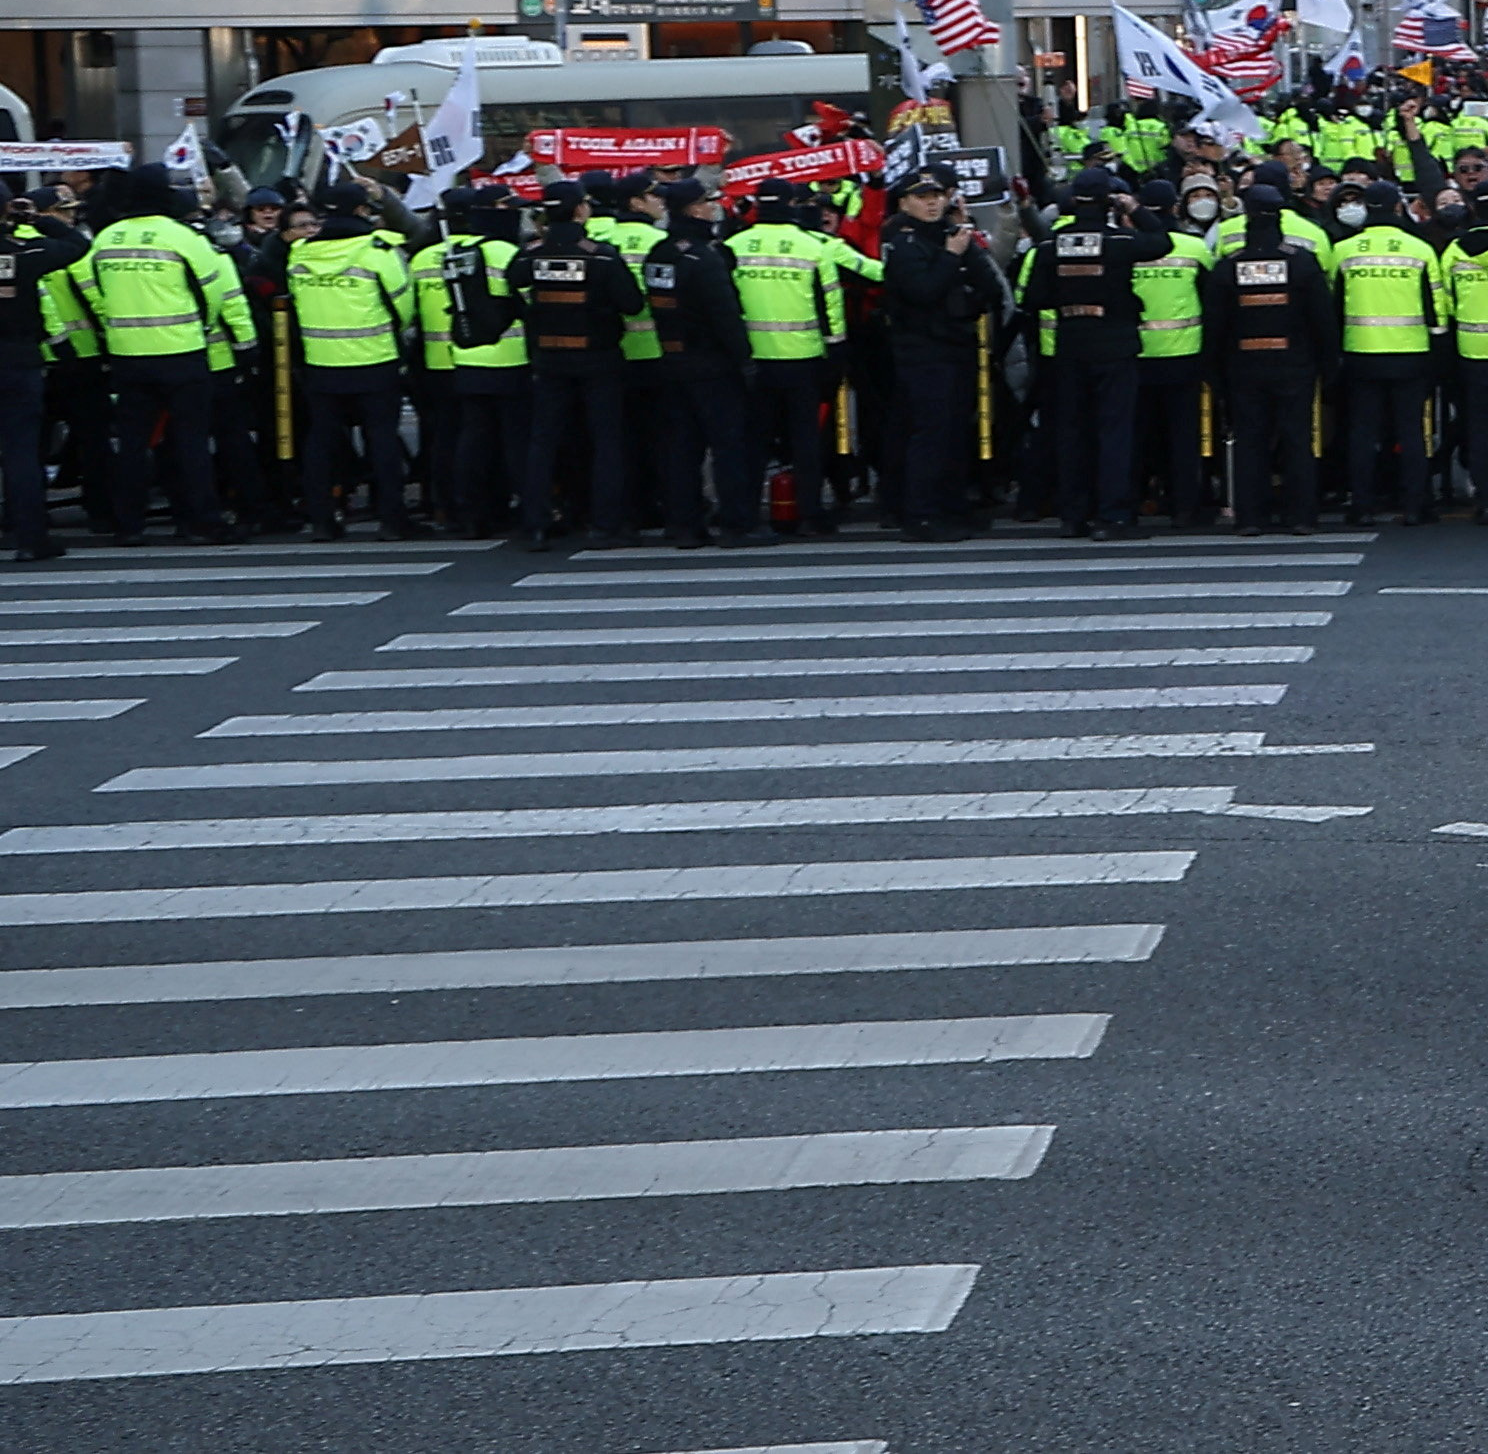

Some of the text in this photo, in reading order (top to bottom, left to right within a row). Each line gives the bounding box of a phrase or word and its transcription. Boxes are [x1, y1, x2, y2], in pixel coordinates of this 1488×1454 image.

[102, 261, 166, 272] POLICE
[737, 269, 802, 282] POLICE
[1131, 269, 1183, 280] OLICE
[1349, 268, 1411, 280] POLICE
